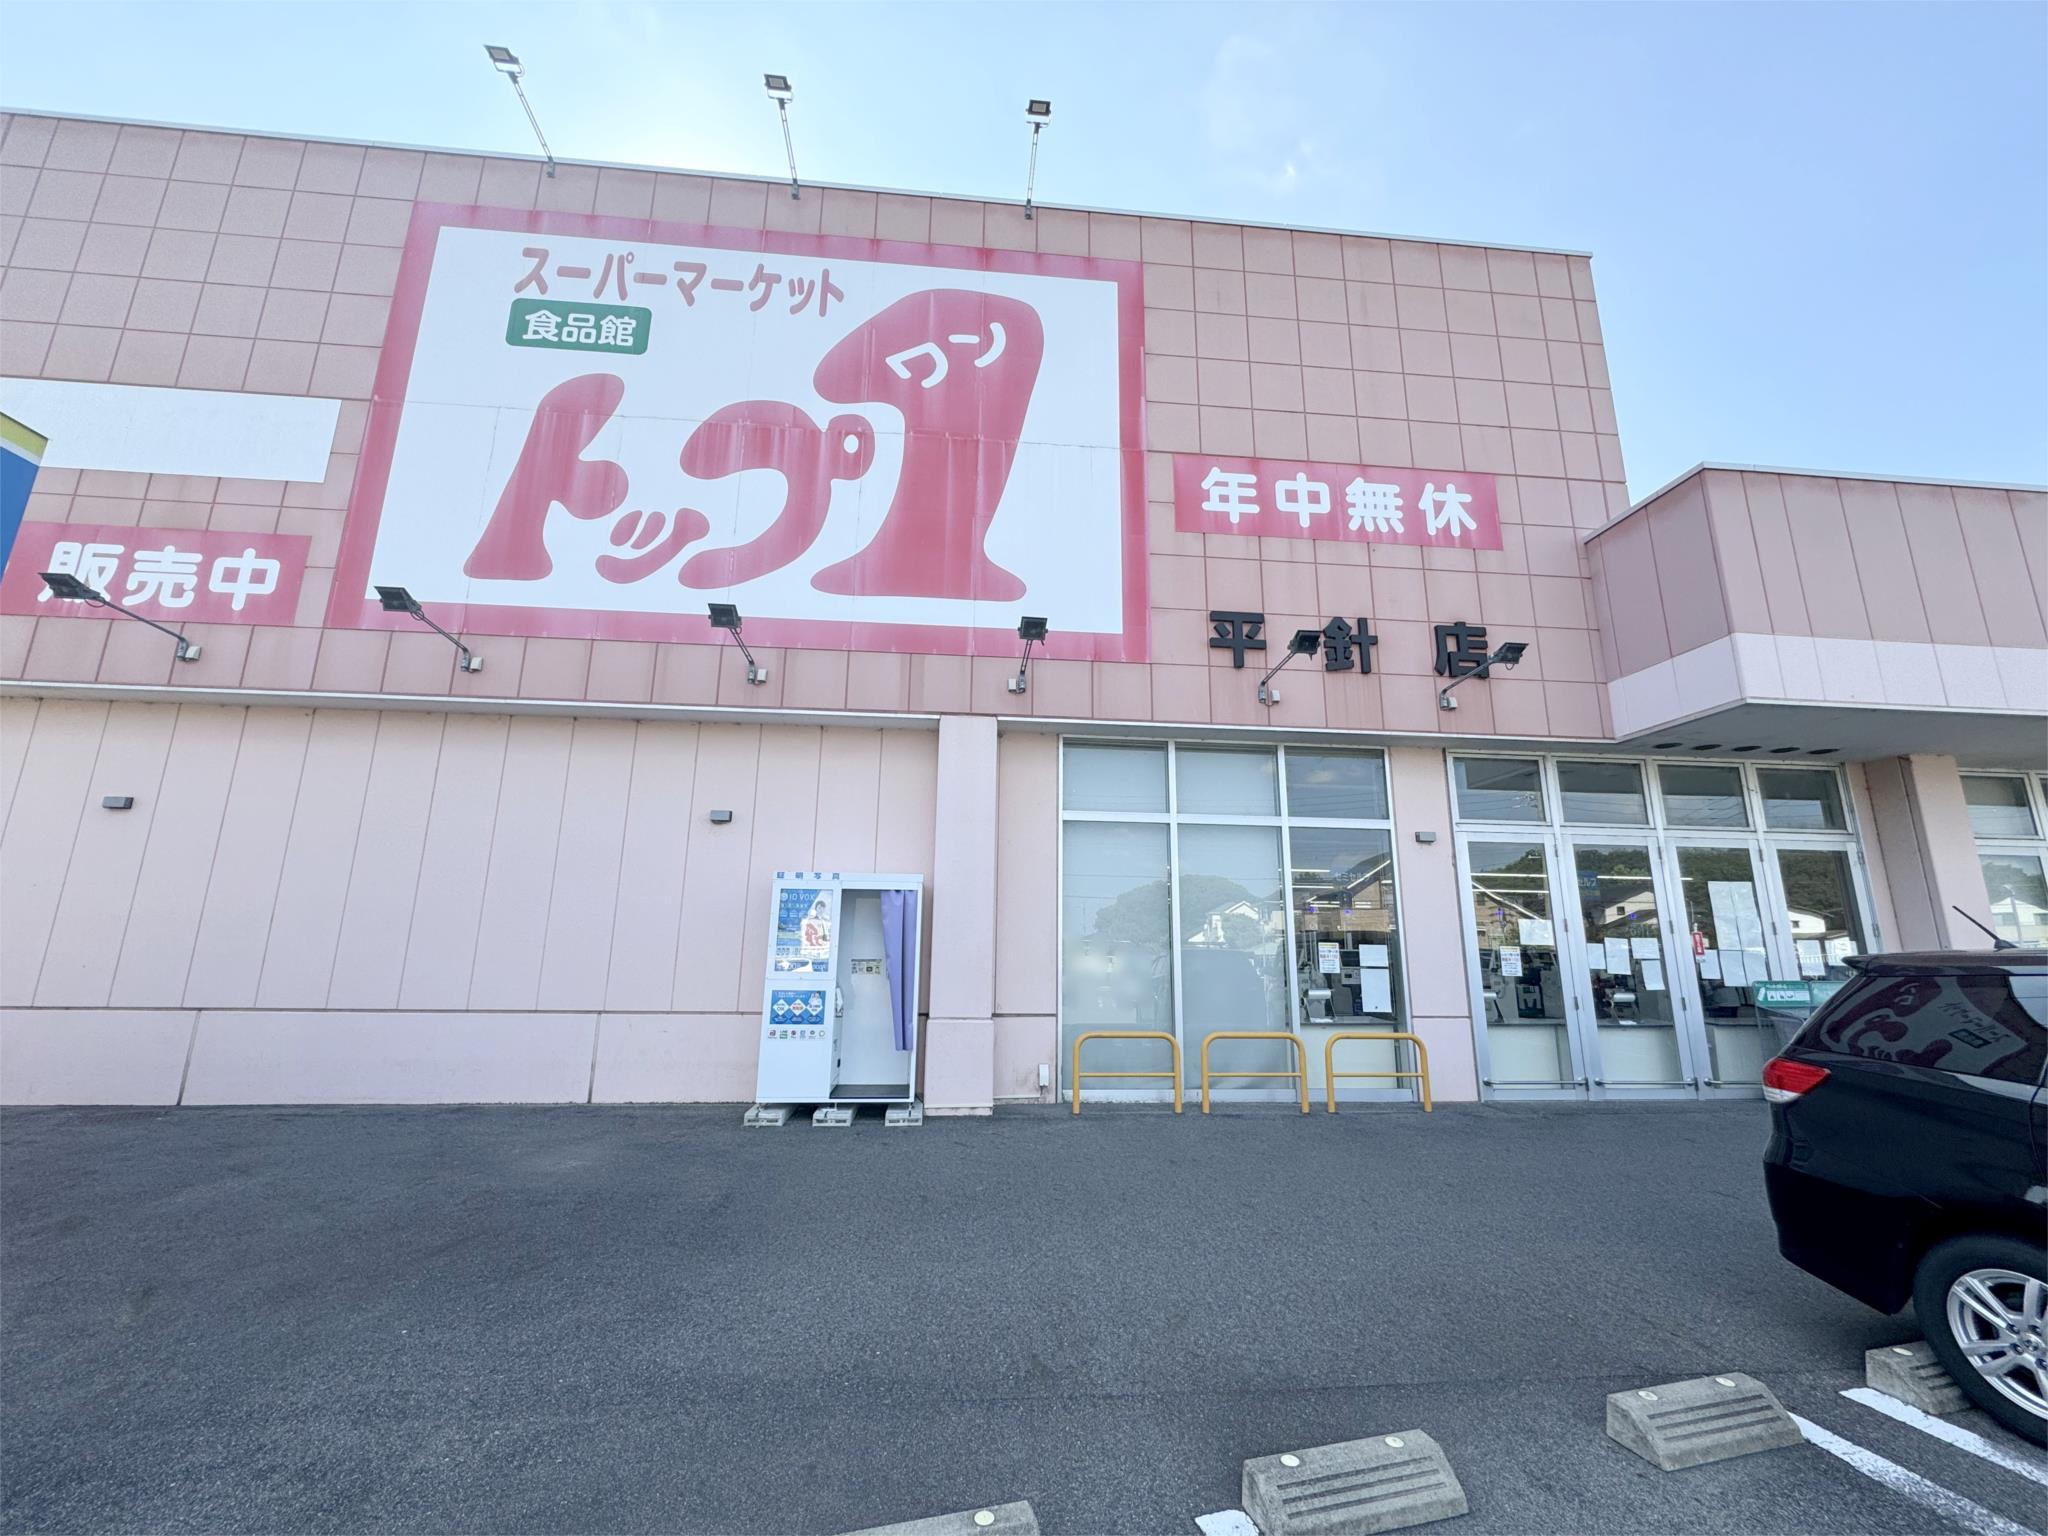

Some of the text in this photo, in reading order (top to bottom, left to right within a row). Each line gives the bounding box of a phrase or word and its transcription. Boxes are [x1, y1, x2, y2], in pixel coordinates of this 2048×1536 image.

[513, 246, 845, 318] スーパーマーケット
[522, 309, 637, 347] 食品館
[1201, 466, 1477, 537] 年中無休
[36, 541, 281, 611] 販売中
[1209, 610, 1490, 679] 平針店
